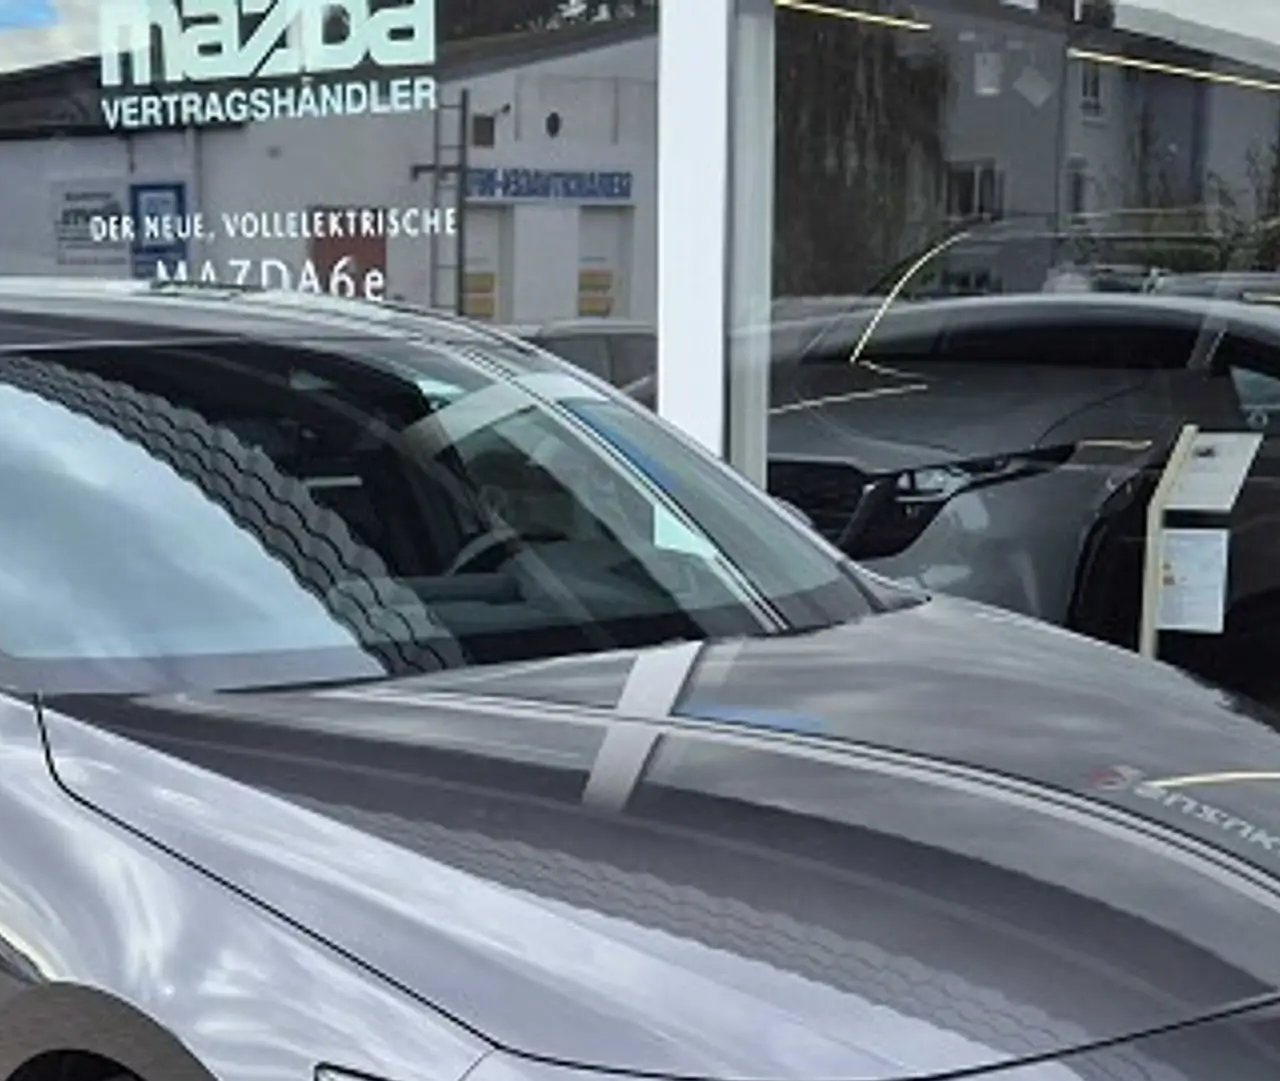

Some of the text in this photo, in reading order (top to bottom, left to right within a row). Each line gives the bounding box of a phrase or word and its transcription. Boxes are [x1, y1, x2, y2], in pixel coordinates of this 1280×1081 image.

[101, 77, 437, 130] VERTRAGSHÄNDLER
[89, 207, 458, 242] DER NEUE, VOLLELEKTRISCHE
